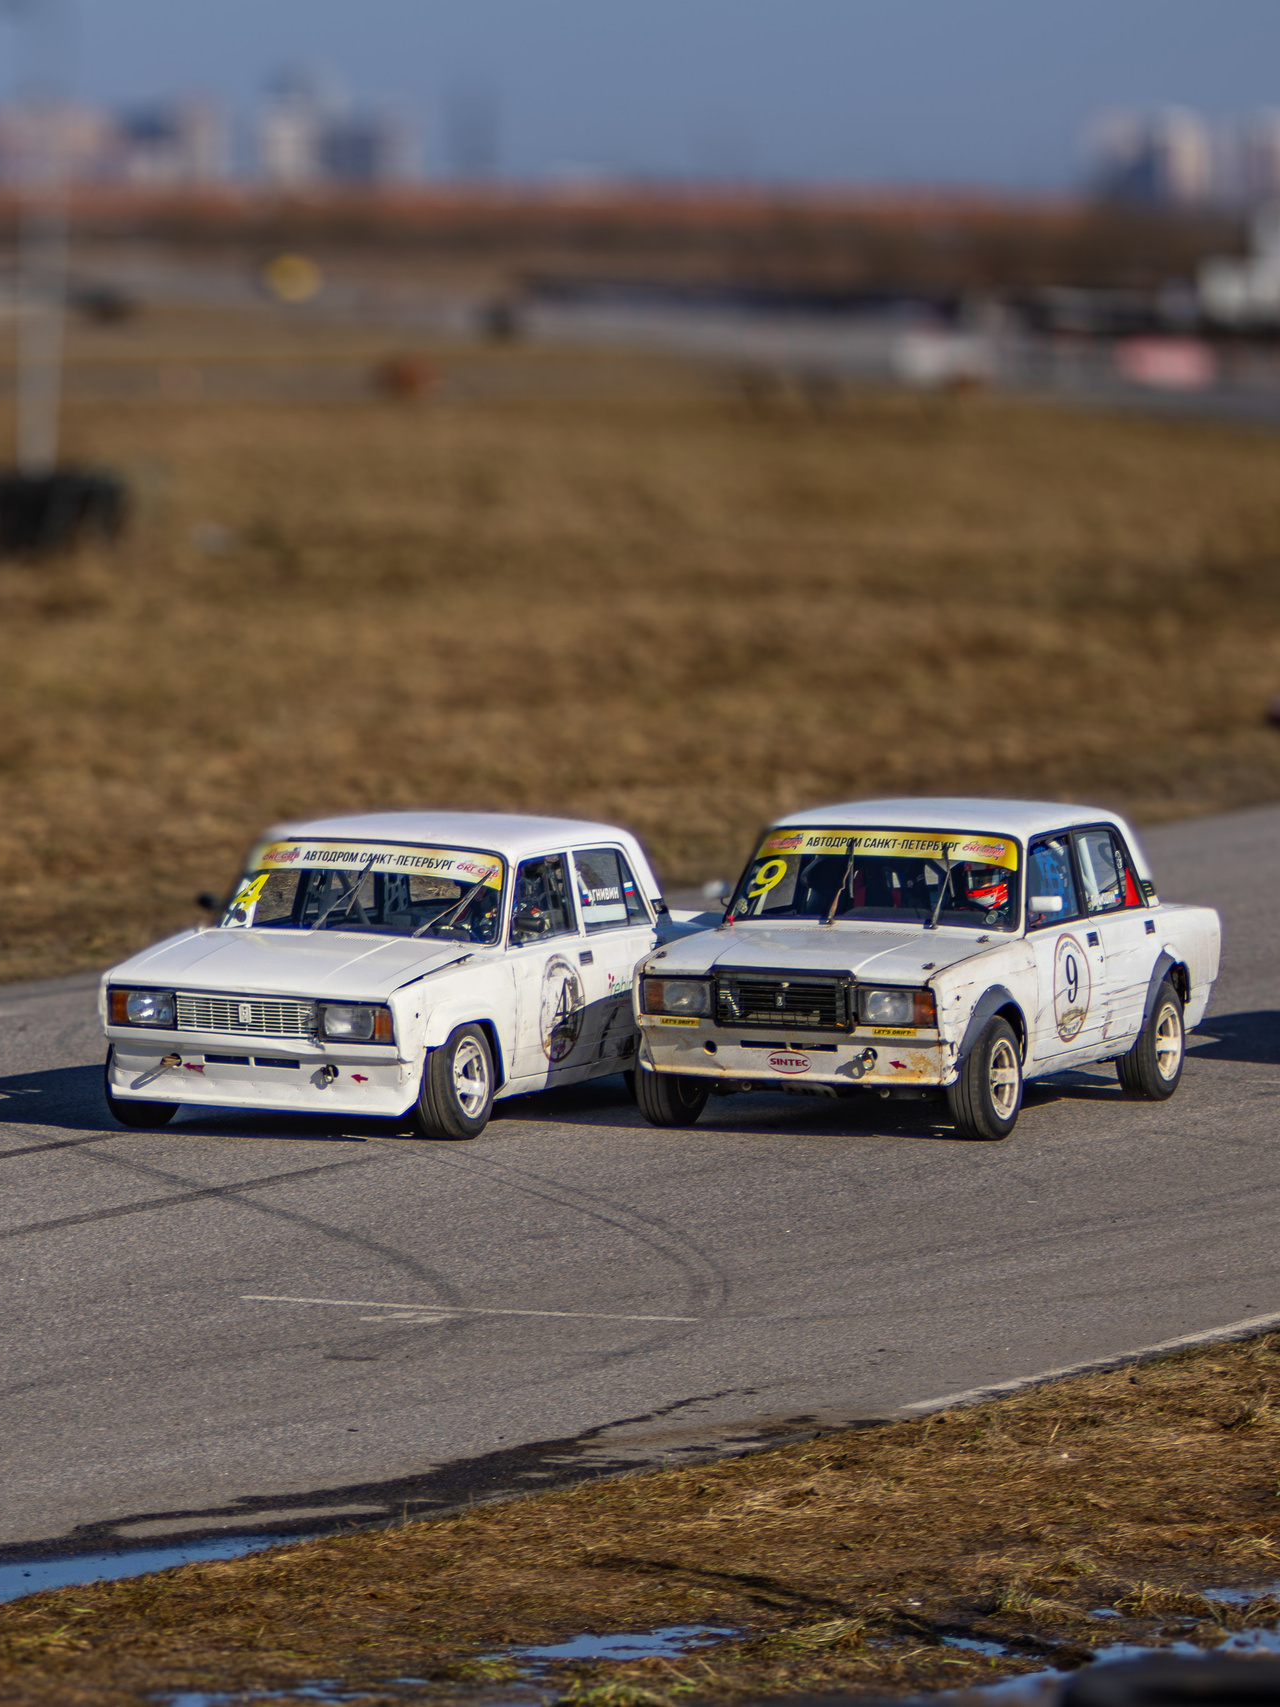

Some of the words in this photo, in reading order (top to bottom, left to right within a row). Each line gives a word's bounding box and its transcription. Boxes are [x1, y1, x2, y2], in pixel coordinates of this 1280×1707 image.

[806, 836, 862, 849] АВТОДРОМ
[863, 837, 961, 853] САНКТ-ПЕТЕРБУРГ
[302, 850, 359, 863] АВТОДРОМ
[359, 851, 456, 871] САНКТ-ПЕТЕРБУРГ
[233, 873, 271, 911] 4
[747, 859, 788, 899] 9
[1065, 954, 1078, 1003] 9
[770, 1058, 809, 1067] SINTEC
